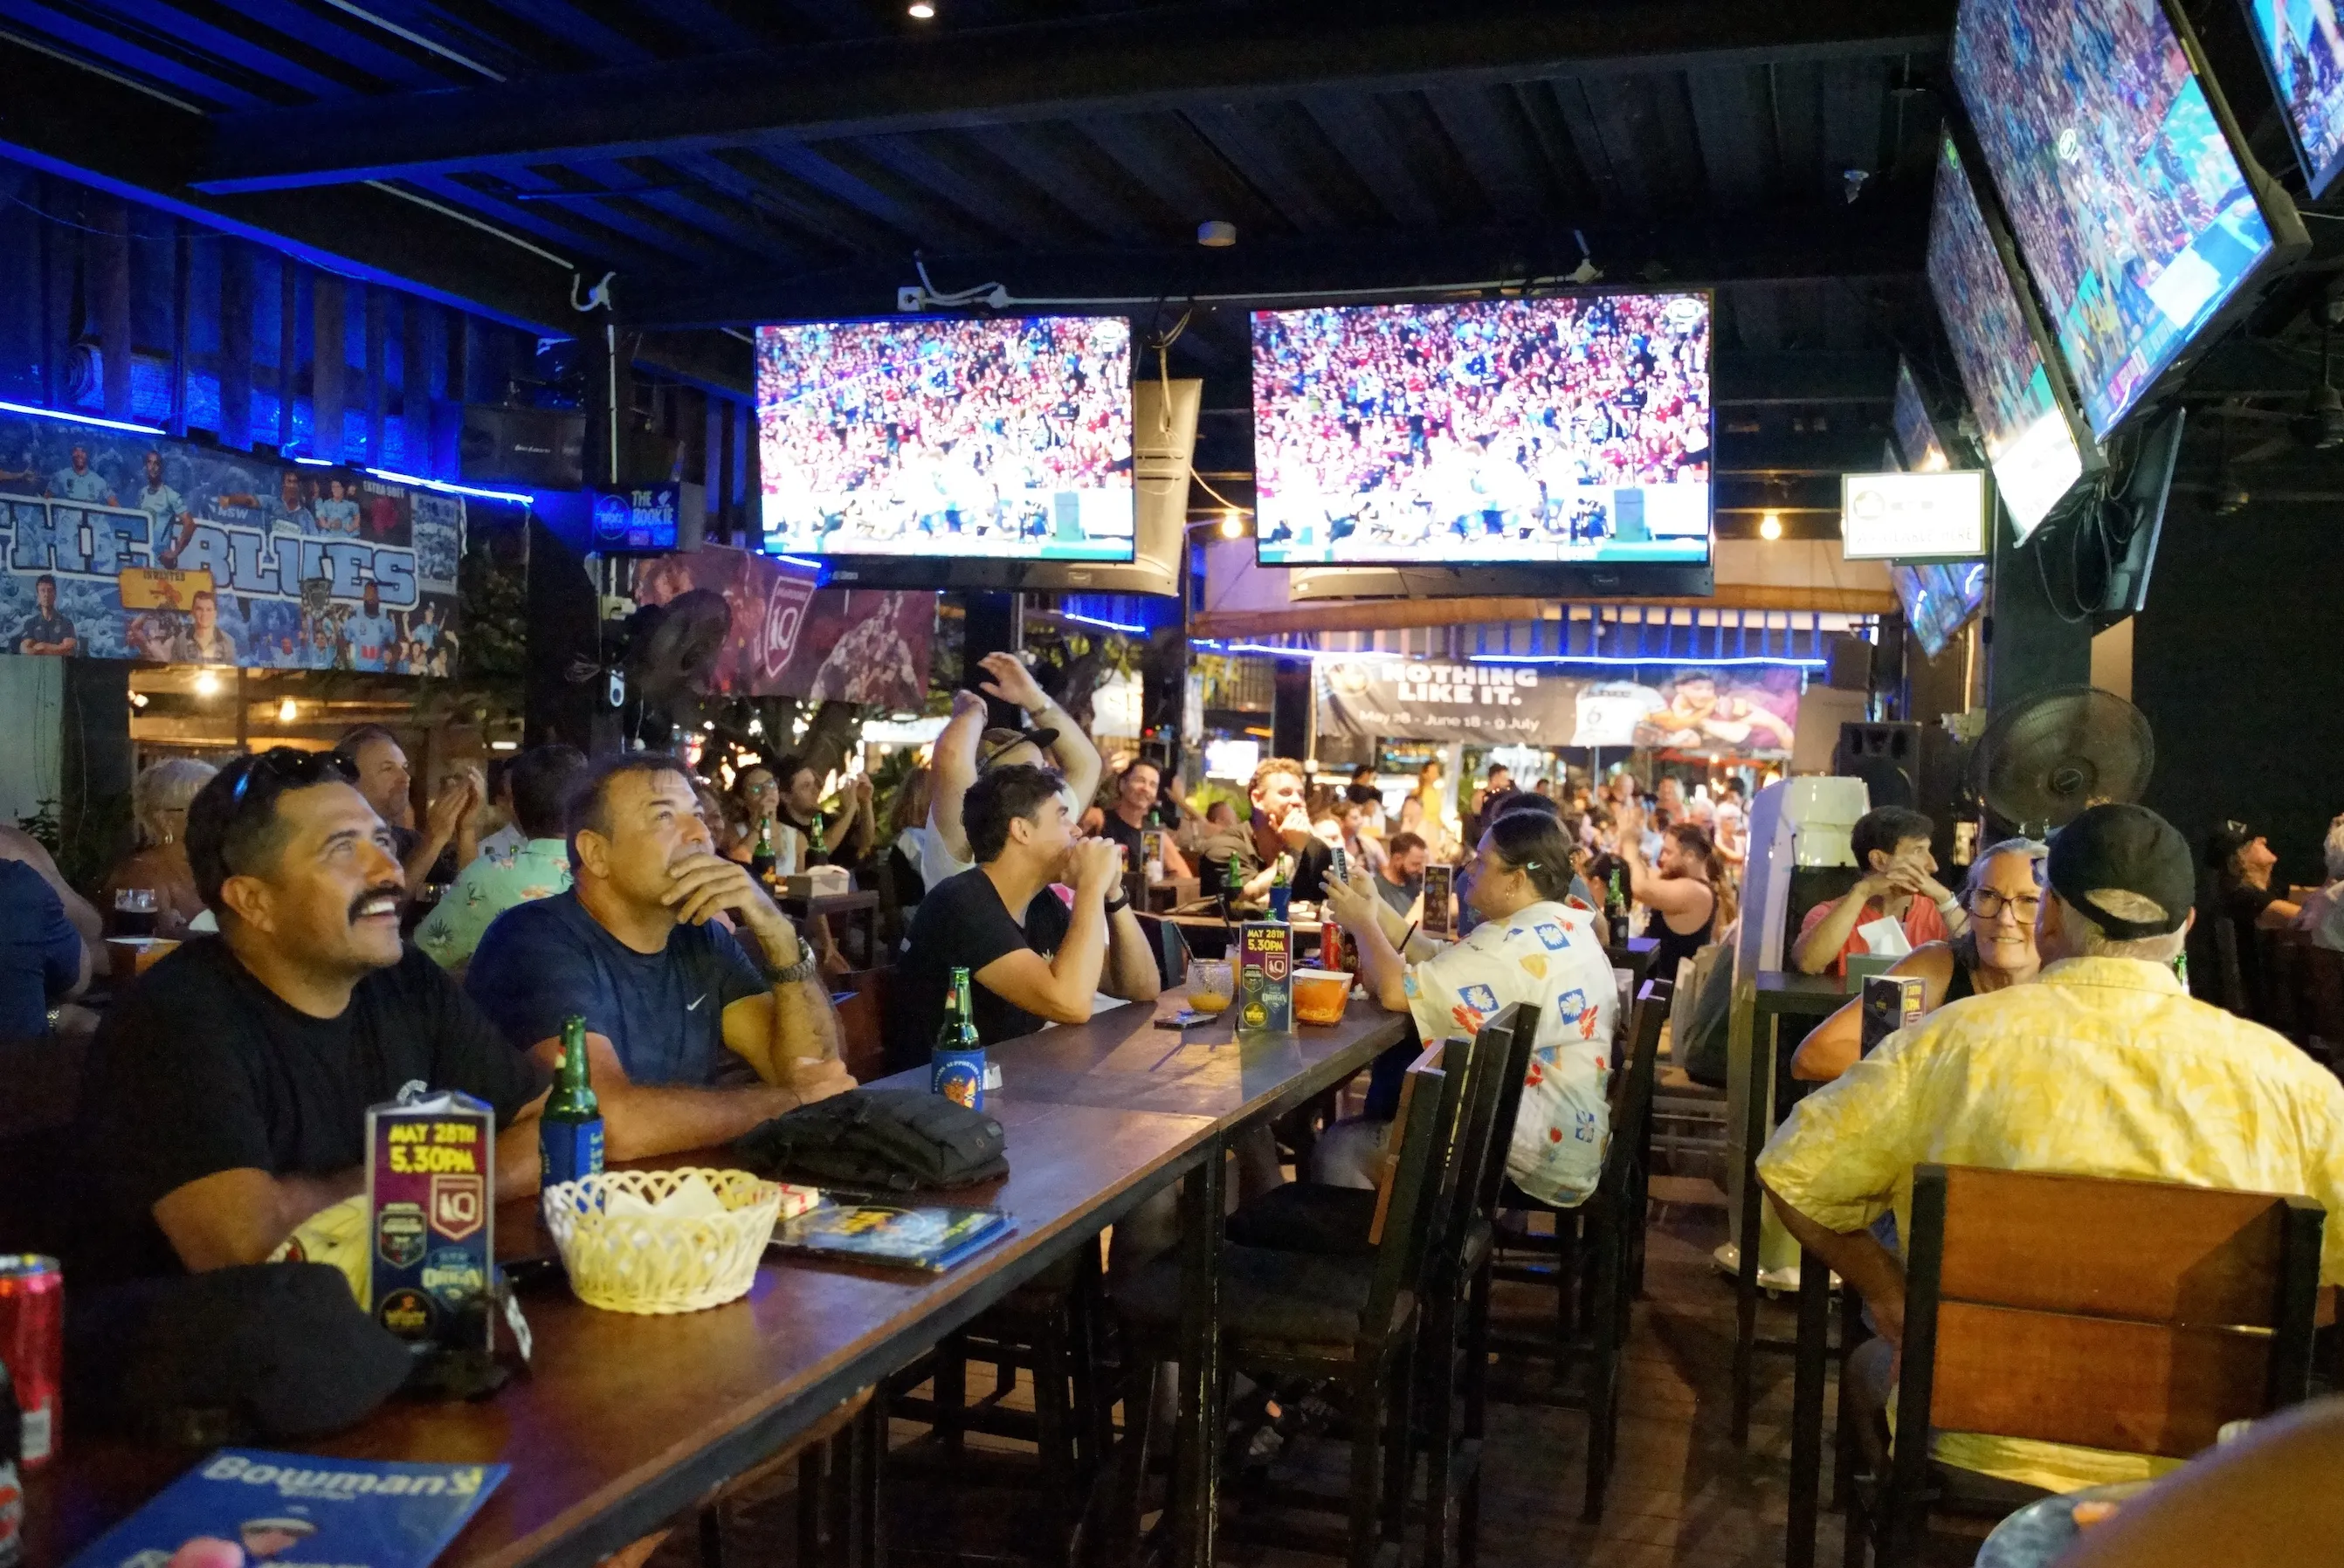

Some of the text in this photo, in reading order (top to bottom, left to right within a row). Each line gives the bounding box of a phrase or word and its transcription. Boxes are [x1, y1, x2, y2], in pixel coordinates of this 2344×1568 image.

[631, 490, 653, 507] THE
[0, 494, 419, 611] HE BLUES
[1381, 663, 1539, 688] NOTHING
[1397, 682, 1523, 706] LIKE IT.
[1359, 709, 1390, 726] May
[1424, 712, 1460, 727] June
[1463, 715, 1482, 728] 18
[1506, 715, 1541, 733] July
[1247, 929, 1286, 939] MAY 28TH
[1247, 939, 1285, 952] 5.30PM
[390, 1145, 476, 1173] 5.30PM
